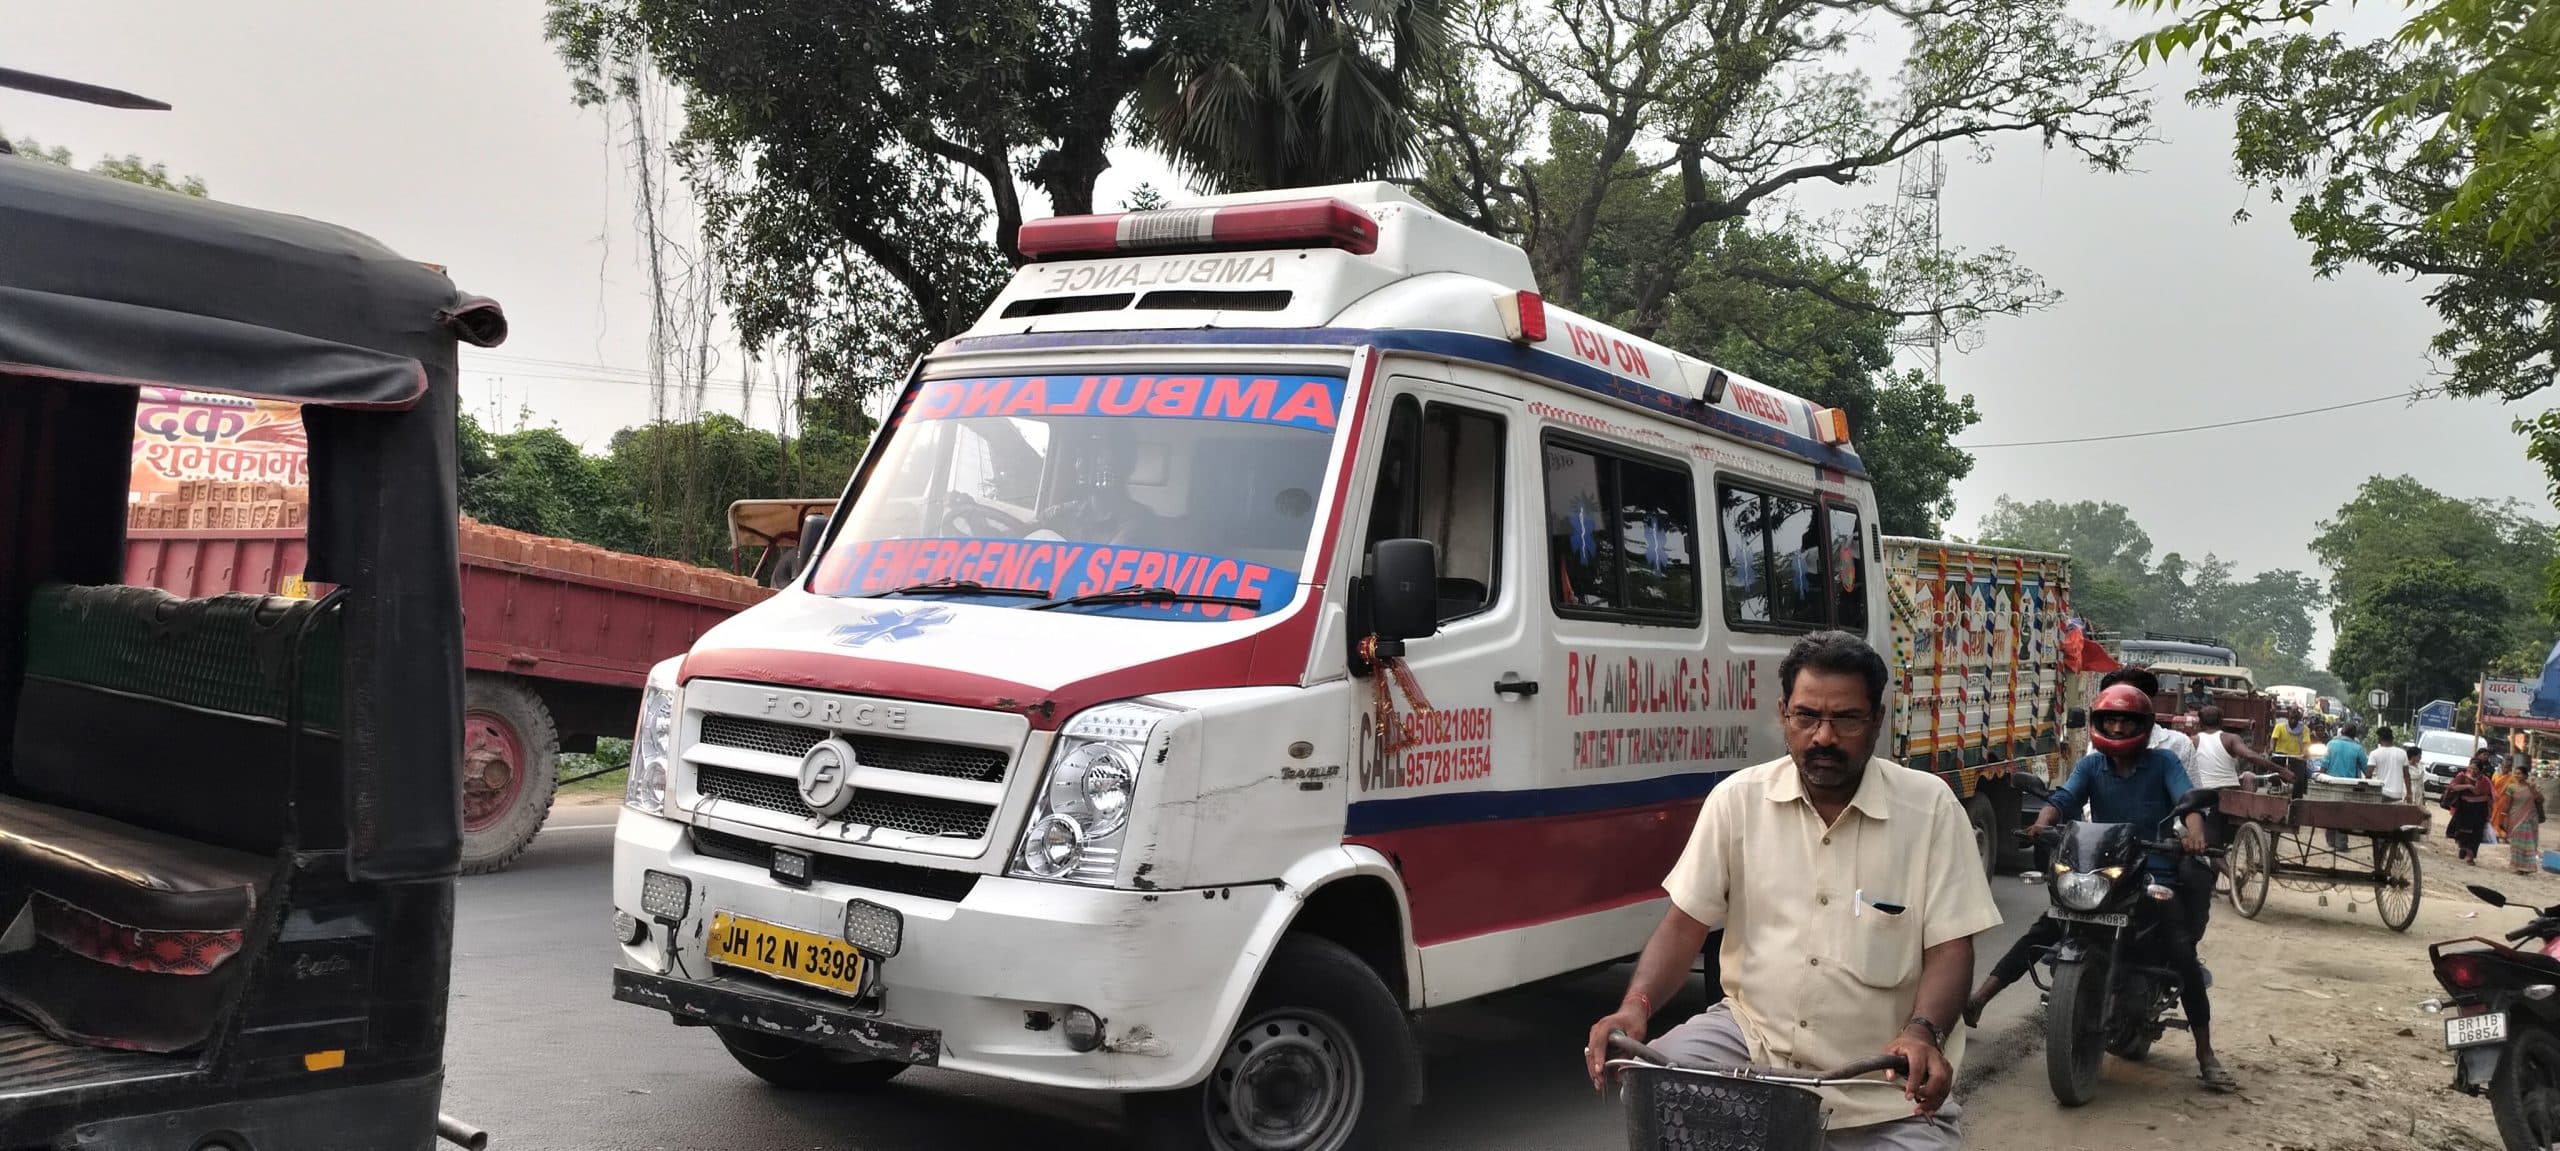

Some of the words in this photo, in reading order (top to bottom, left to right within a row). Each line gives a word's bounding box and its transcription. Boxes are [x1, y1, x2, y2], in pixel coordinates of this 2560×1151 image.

[1564, 322, 1611, 366] ICU
[1613, 339, 1651, 379] ON
[1729, 382, 1789, 425] WHEELS
[862, 540, 1082, 600] EMERGENCY
[1077, 547, 1271, 620] SERVICE
[1567, 651, 1597, 715] R.Y.
[1701, 657, 1756, 712] SVICE
[762, 696, 909, 730] FORCE
[1406, 744, 1492, 788] 9572815554
[1573, 728, 1625, 770] PATIENT
[723, 926, 750, 957] JH
[756, 933, 777, 964] 12
[782, 940, 799, 969] N
[805, 944, 858, 982] 3398
[2458, 1015, 2498, 1031] BR11B
